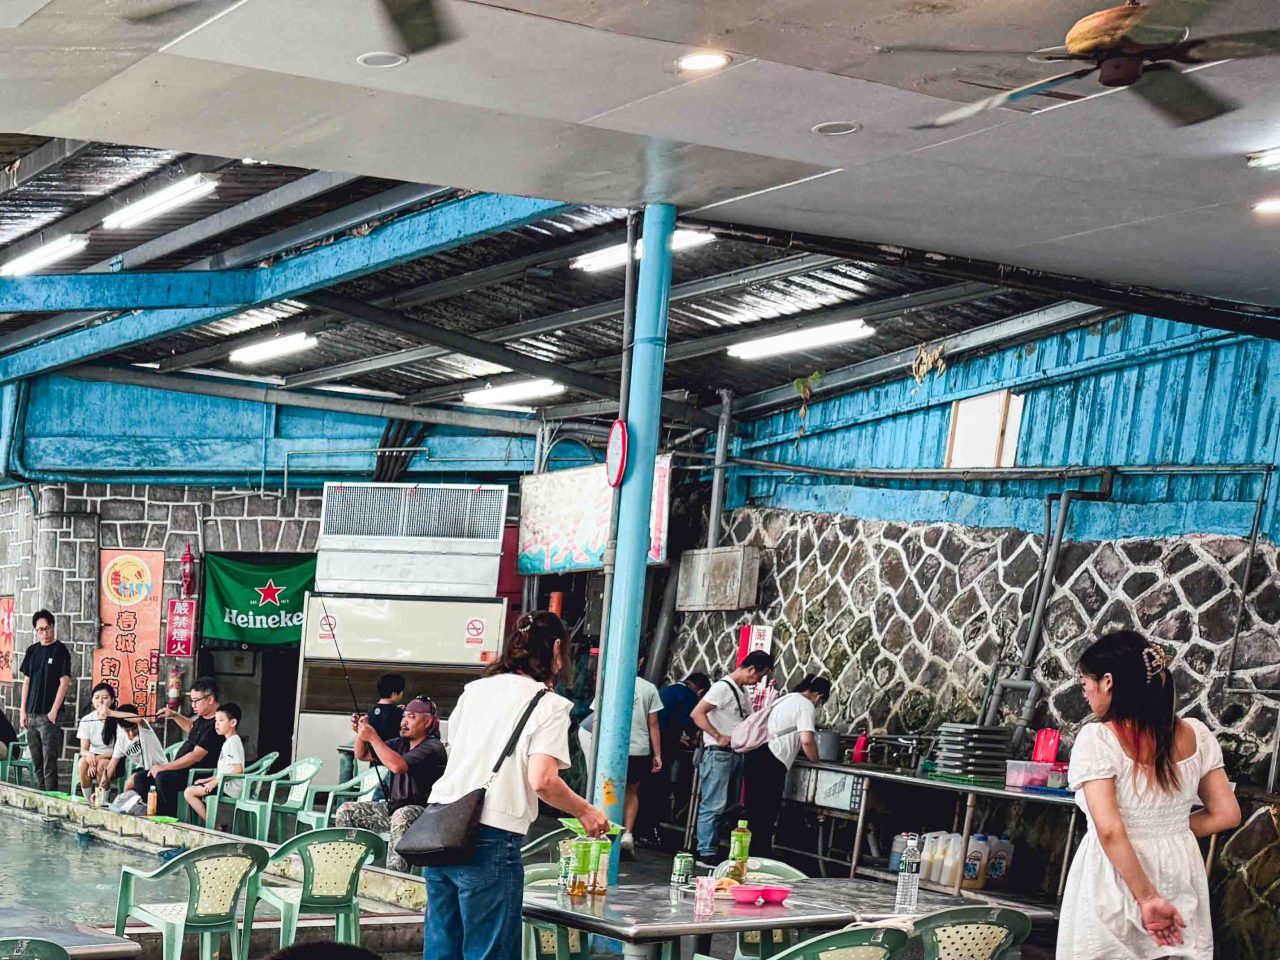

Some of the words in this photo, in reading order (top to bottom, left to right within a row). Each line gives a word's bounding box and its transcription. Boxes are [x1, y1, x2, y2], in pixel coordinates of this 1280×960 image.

[116, 610, 137, 653] 春城
[171, 601, 190, 655] 嚴禁煙火
